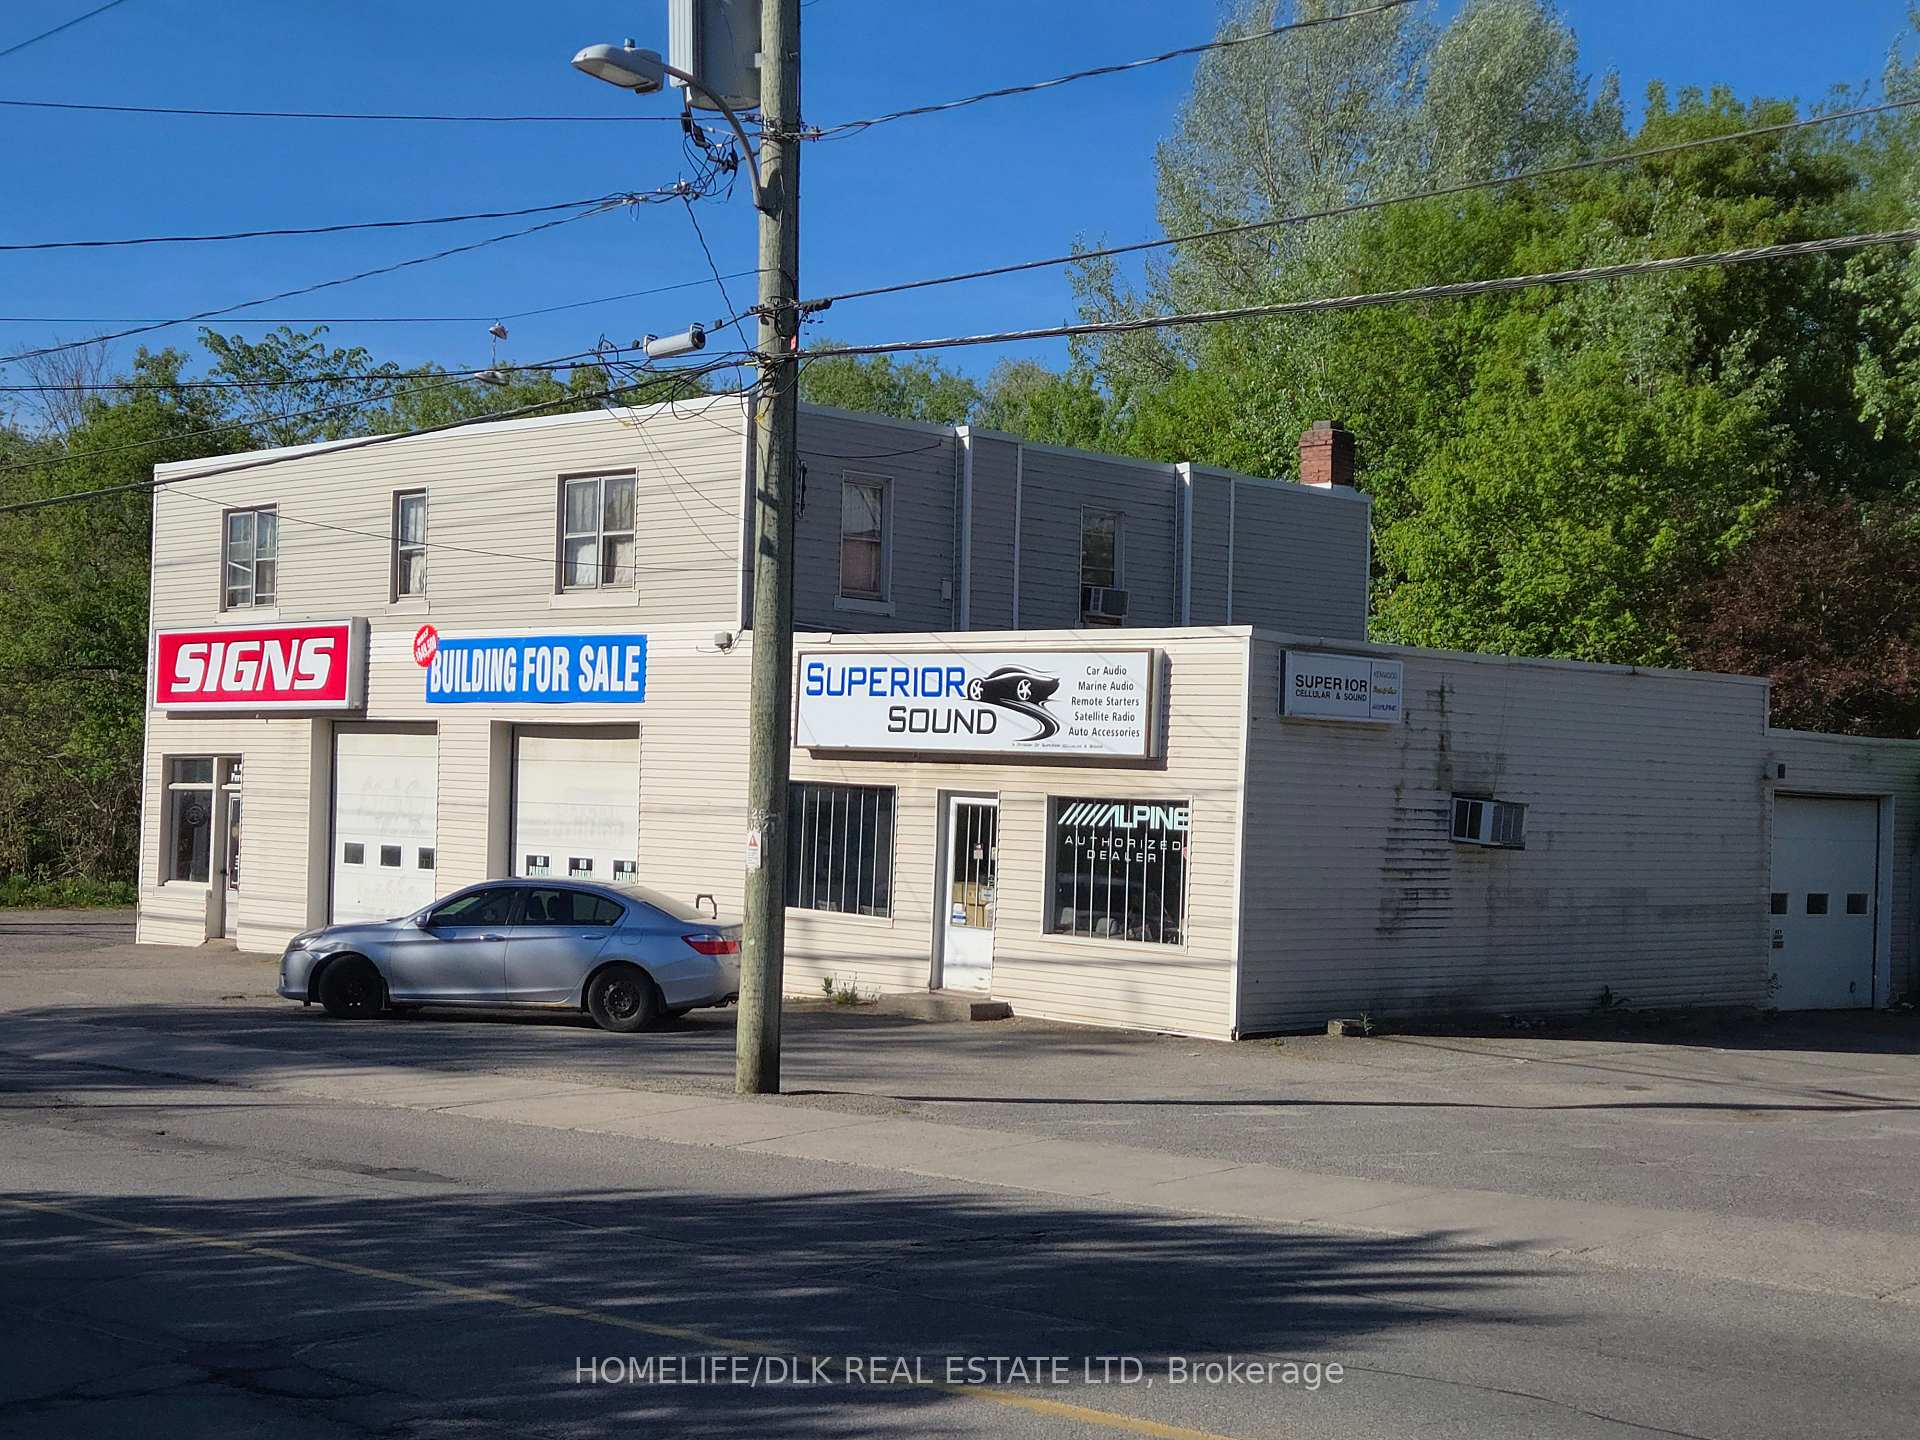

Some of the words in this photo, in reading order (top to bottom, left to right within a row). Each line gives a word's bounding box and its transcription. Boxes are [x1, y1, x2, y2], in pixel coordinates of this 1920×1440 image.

[171, 637, 334, 693] SIGNS
[430, 647, 517, 693] BUILDING
[522, 646, 570, 693] FOR
[578, 644, 641, 693] SALE
[1086, 665, 1100, 676] Car
[1103, 665, 1127, 676] Audio
[806, 662, 966, 698] SUPERIOR
[1078, 680, 1107, 691] Marine
[1110, 680, 1134, 691] Audio
[1295, 674, 1368, 693] SUPERIOR
[1071, 696, 1103, 706] Remote
[1106, 696, 1140, 707] Starters
[1295, 689, 1331, 699] CELLULAR
[1344, 692, 1368, 702] SOUND
[888, 705, 997, 735] SOUND
[1074, 711, 1109, 722] Satellite
[1112, 711, 1136, 722] Radio
[1068, 726, 1089, 737] Auto
[1091, 726, 1140, 738] Accessories
[1097, 804, 1190, 831] ALPINE
[1064, 835, 1182, 851] AUTHORIZED
[1087, 849, 1156, 863] DEALER
